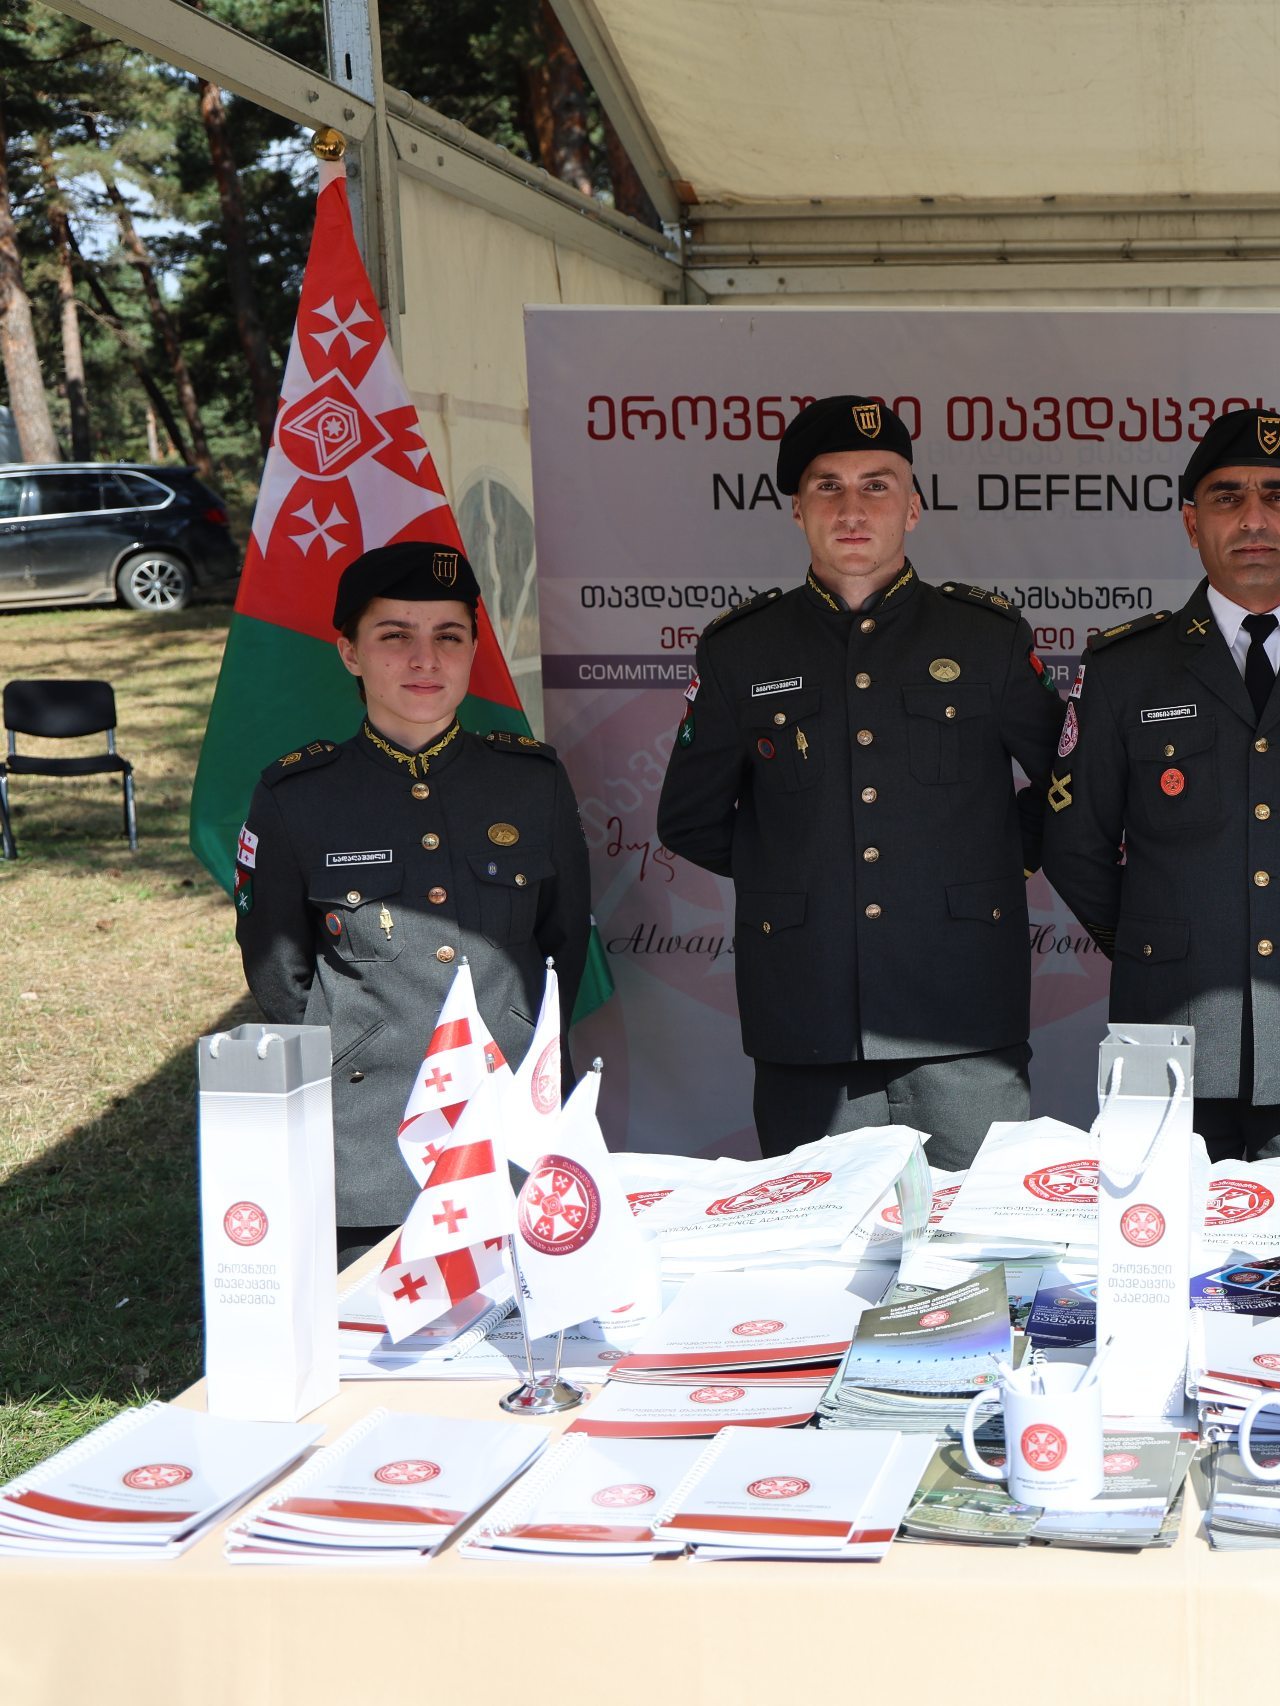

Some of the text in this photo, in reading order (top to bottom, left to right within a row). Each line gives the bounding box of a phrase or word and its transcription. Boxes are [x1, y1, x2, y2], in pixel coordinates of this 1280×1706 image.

[586, 395, 922, 442] ეროვნი
[947, 395, 1277, 443] თავდაცვ
[578, 664, 699, 681] COMMITMEN
[1028, 922, 1101, 957] Hom
[660, 1223, 704, 1233] ATIONAL
[217, 1263, 277, 1275] ეროვნული
[1111, 1263, 1173, 1275] ეროვნული
[214, 1278, 281, 1290] თავდაცვის
[1108, 1278, 1176, 1290] თავდაცვის
[219, 1294, 276, 1305] აკადემია
[1113, 1293, 1171, 1304] აკადემია
